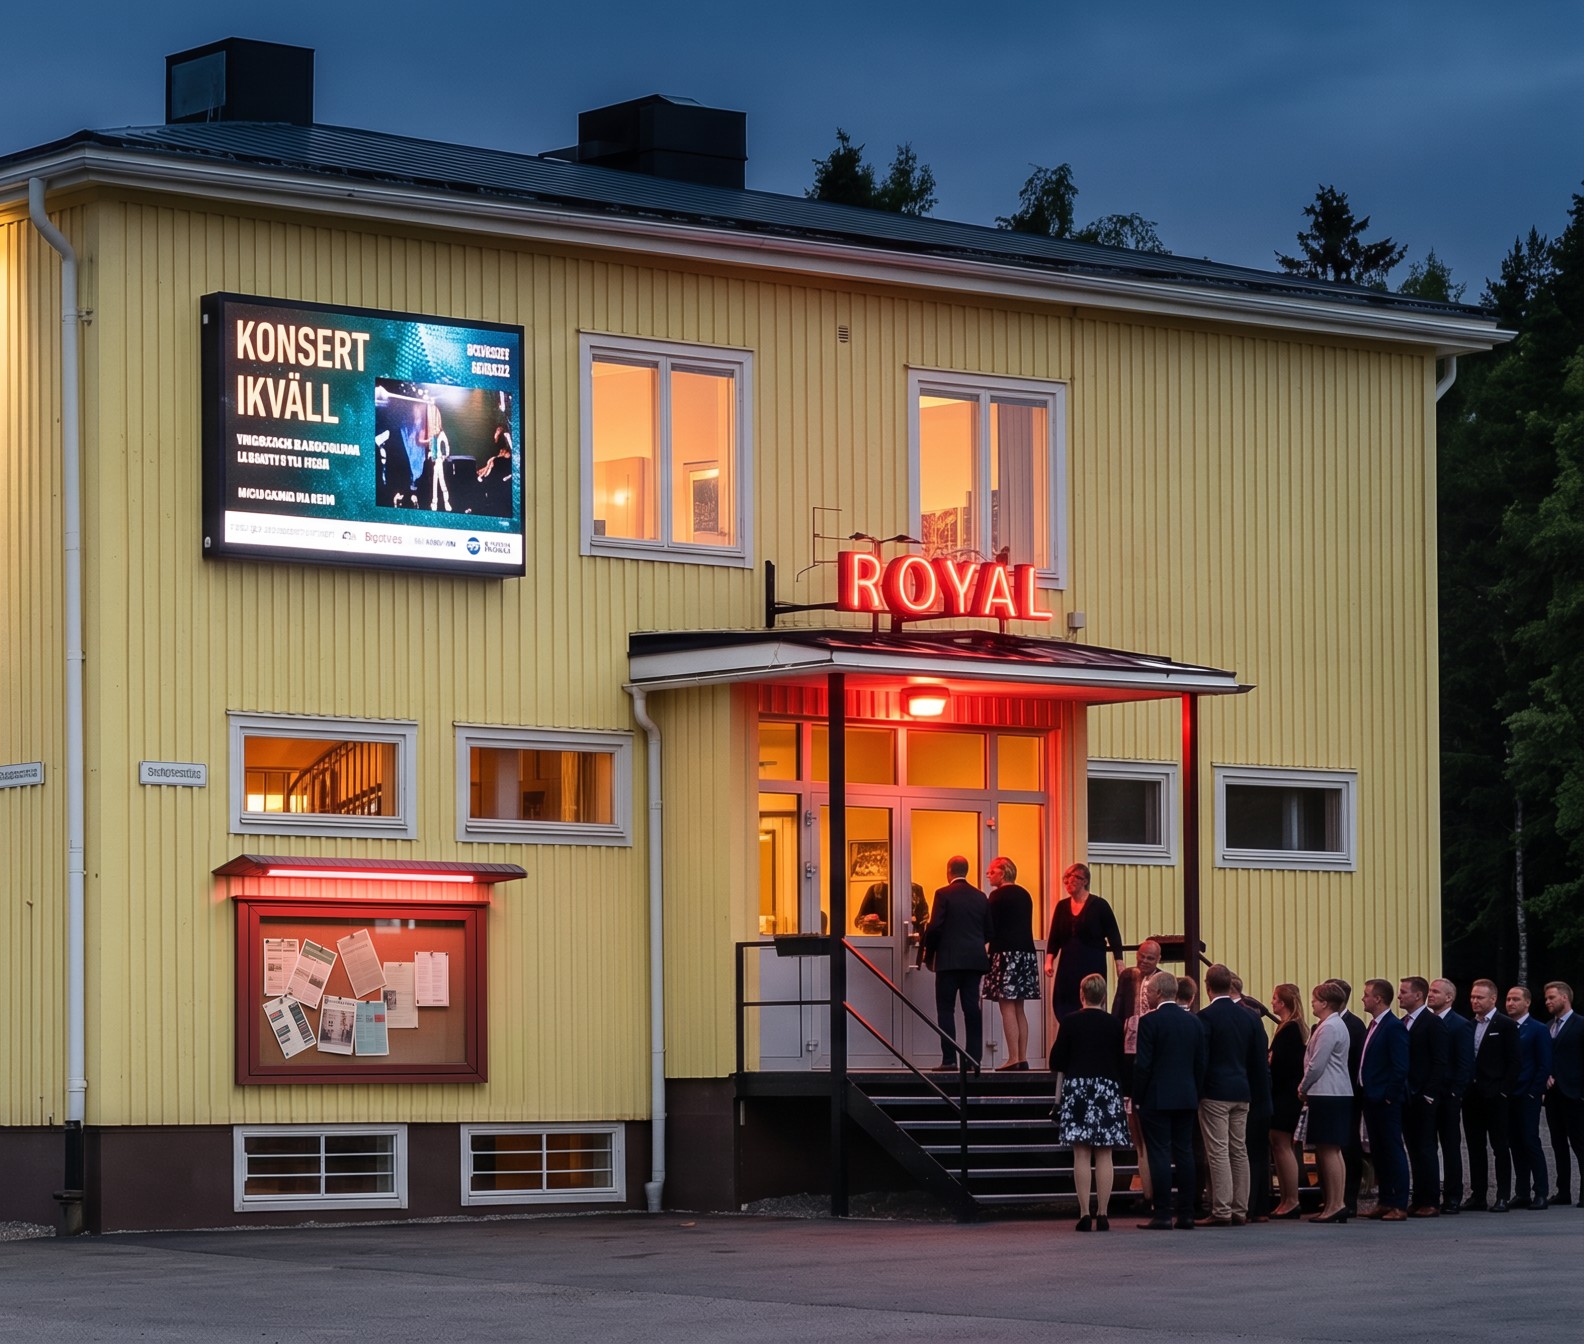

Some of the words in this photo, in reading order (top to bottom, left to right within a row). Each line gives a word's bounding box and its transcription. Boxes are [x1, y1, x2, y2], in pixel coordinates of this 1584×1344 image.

[236, 319, 370, 372] KONSERT
[236, 372, 339, 424] IKVÄLL
[838, 551, 1054, 621] ROYAL
